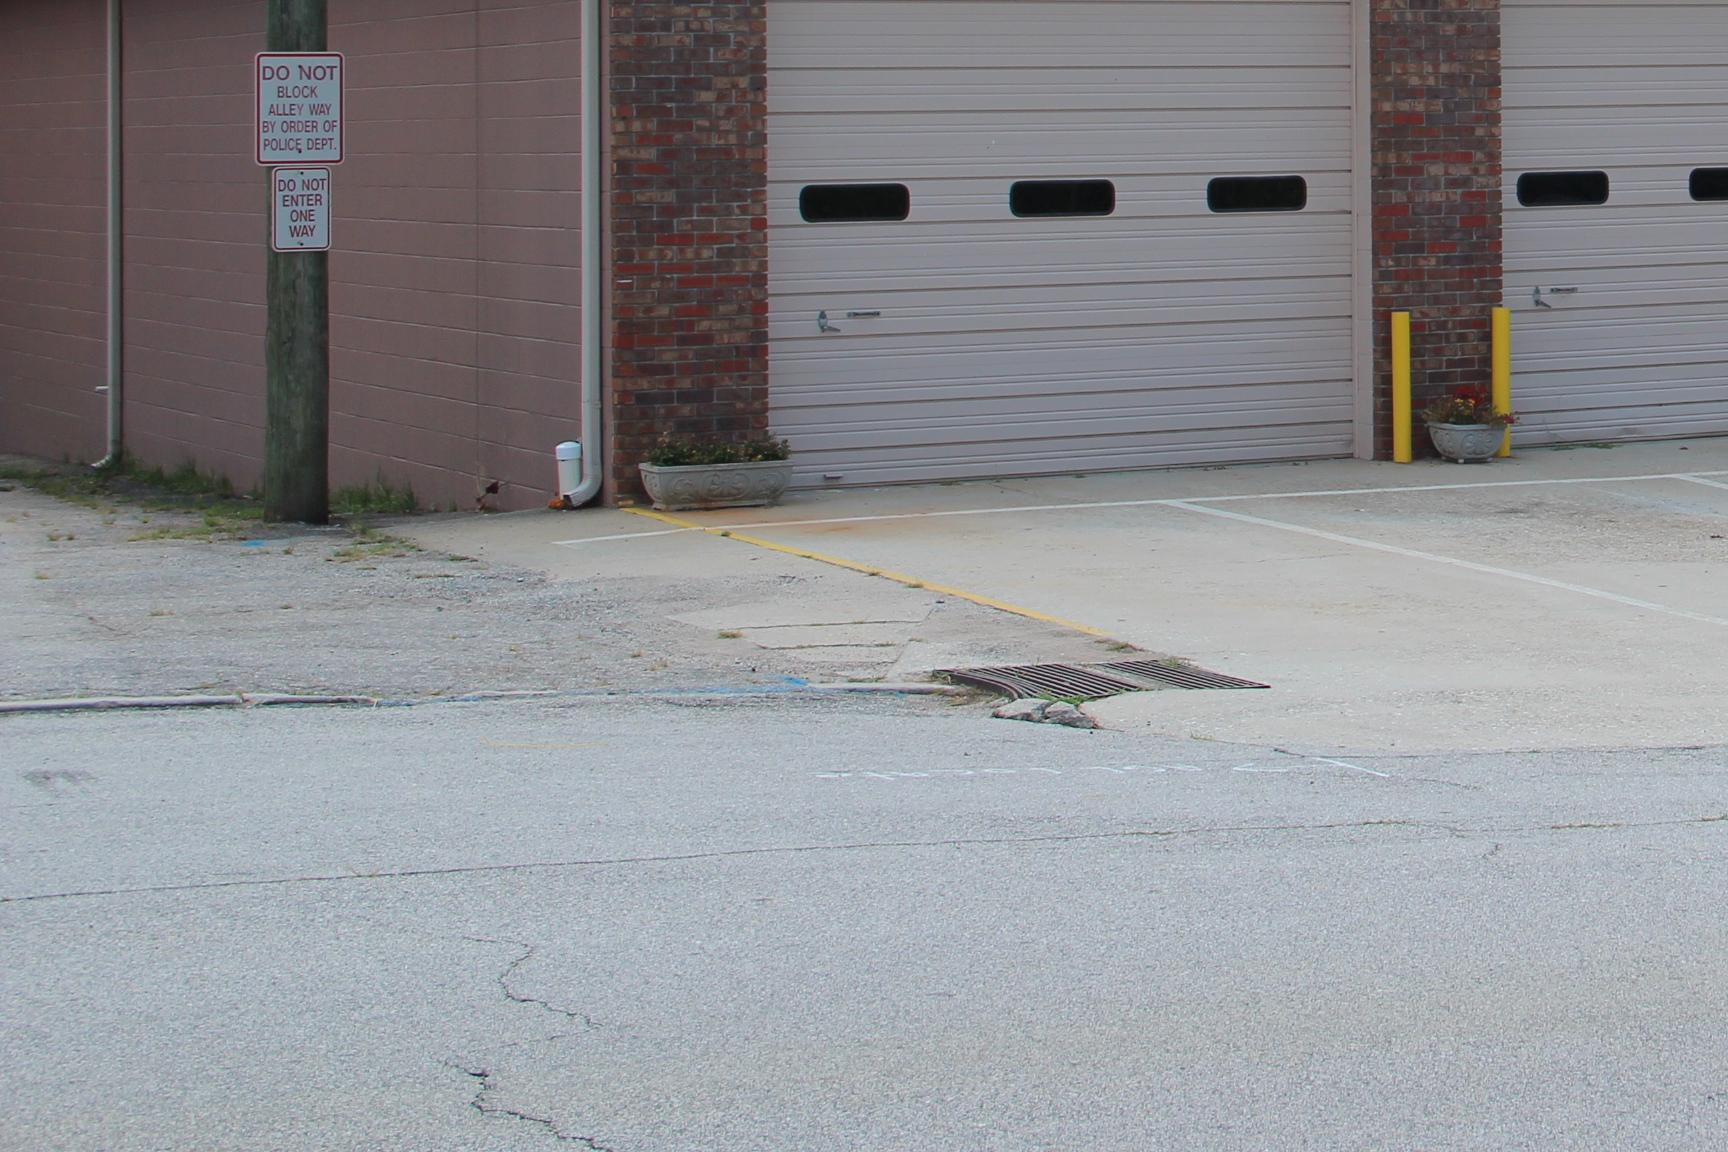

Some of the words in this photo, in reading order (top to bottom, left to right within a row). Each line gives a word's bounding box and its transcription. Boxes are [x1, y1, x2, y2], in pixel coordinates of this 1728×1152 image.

[262, 65, 290, 81] DO
[299, 65, 338, 81] NOT
[277, 85, 318, 98] BLOCK
[268, 103, 304, 116] ALLEY
[309, 103, 332, 116] WAY
[262, 120, 276, 133] BY
[281, 120, 318, 133] ORDER
[323, 120, 338, 133] OF
[263, 138, 302, 151] POLICE
[307, 138, 337, 151] DEPT.
[278, 179, 296, 192] DO
[302, 178, 327, 191] NOT
[282, 194, 323, 207] ENTER
[290, 209, 315, 222] ONE
[289, 225, 316, 237] WAY
